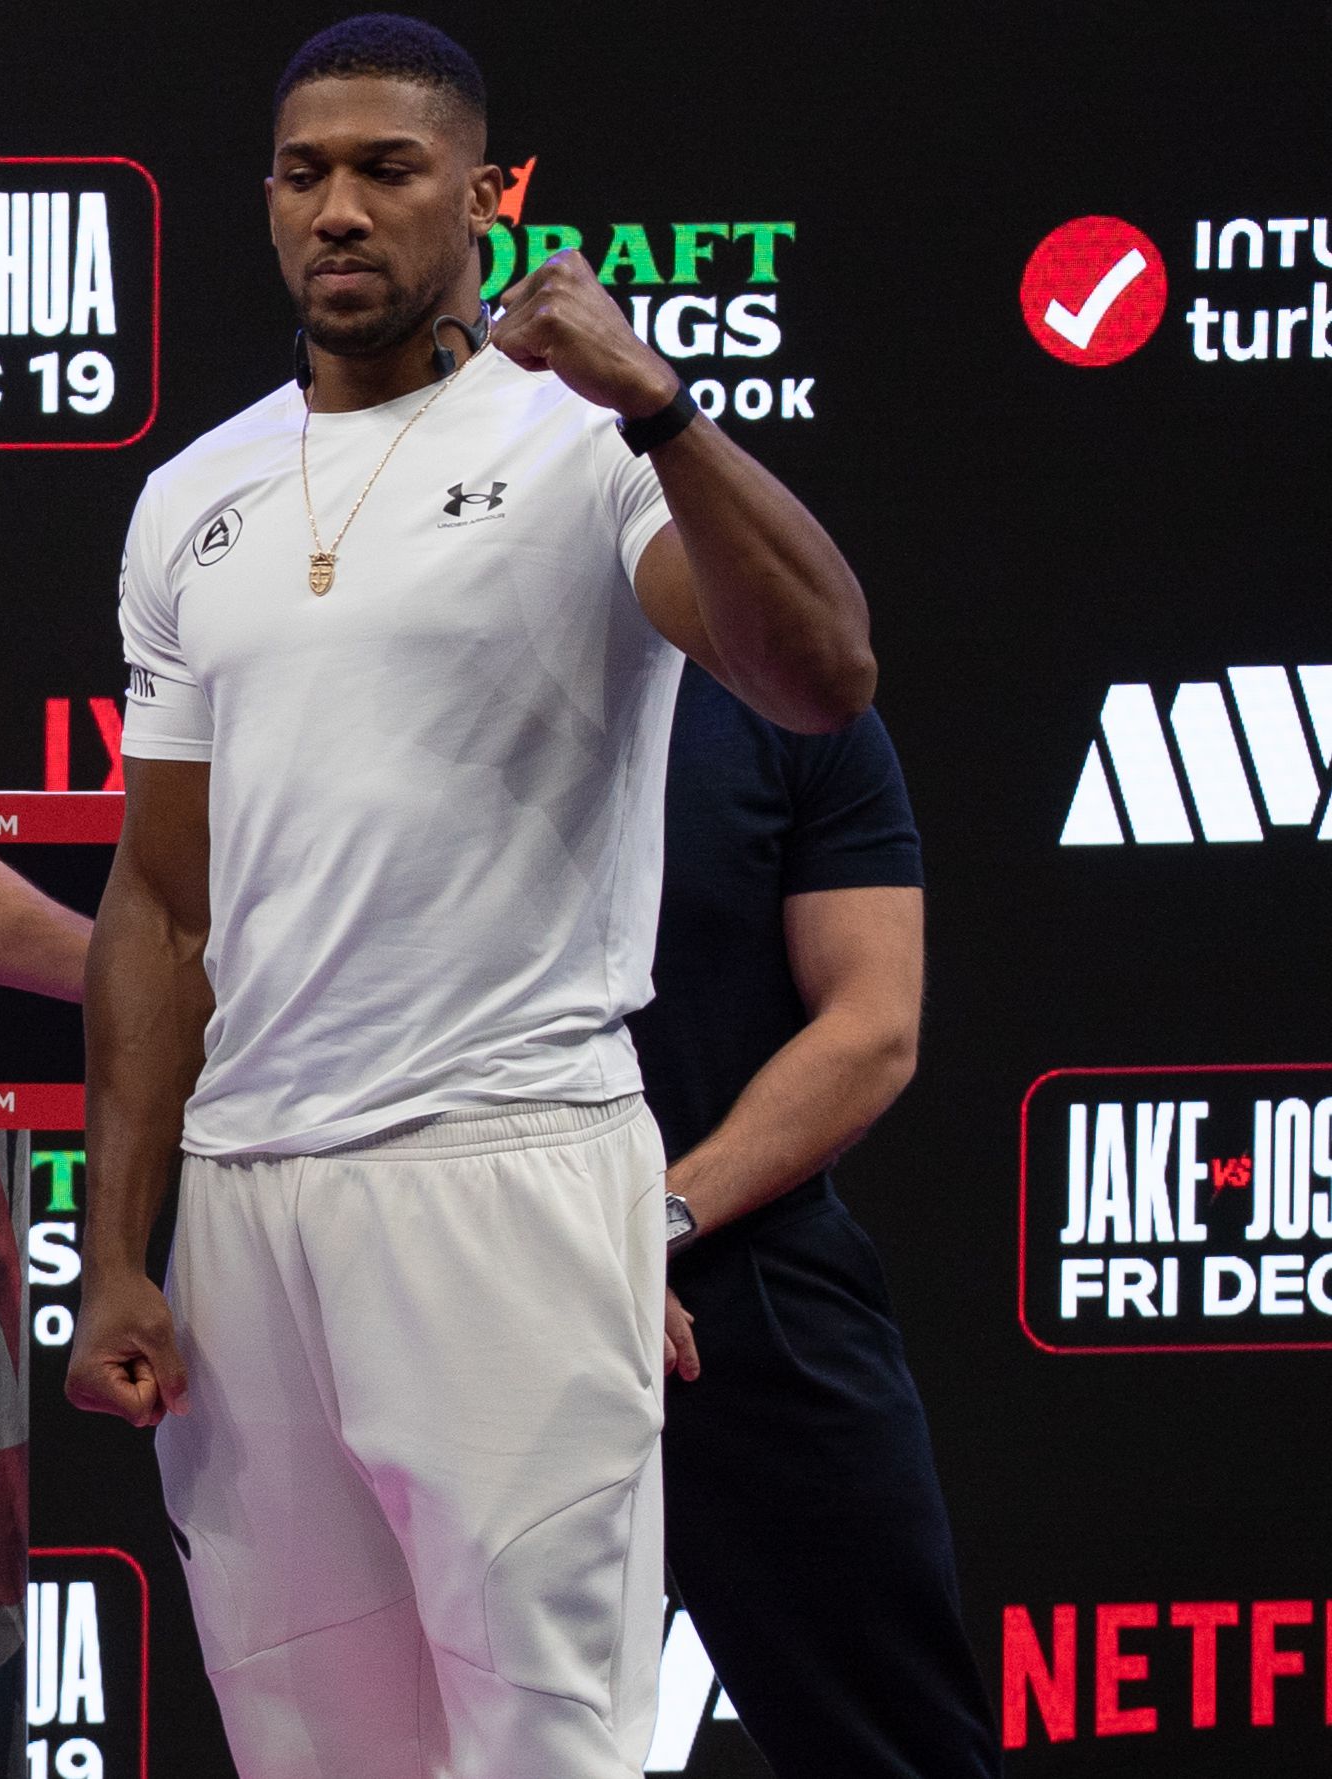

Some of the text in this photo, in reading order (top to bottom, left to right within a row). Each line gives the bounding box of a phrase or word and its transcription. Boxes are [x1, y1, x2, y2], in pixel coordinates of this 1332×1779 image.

[29, 351, 116, 415] 19
[1060, 1101, 1209, 1244] JAKE
[1060, 1258, 1179, 1319] FRI
[1002, 1599, 1332, 1750] NETF
